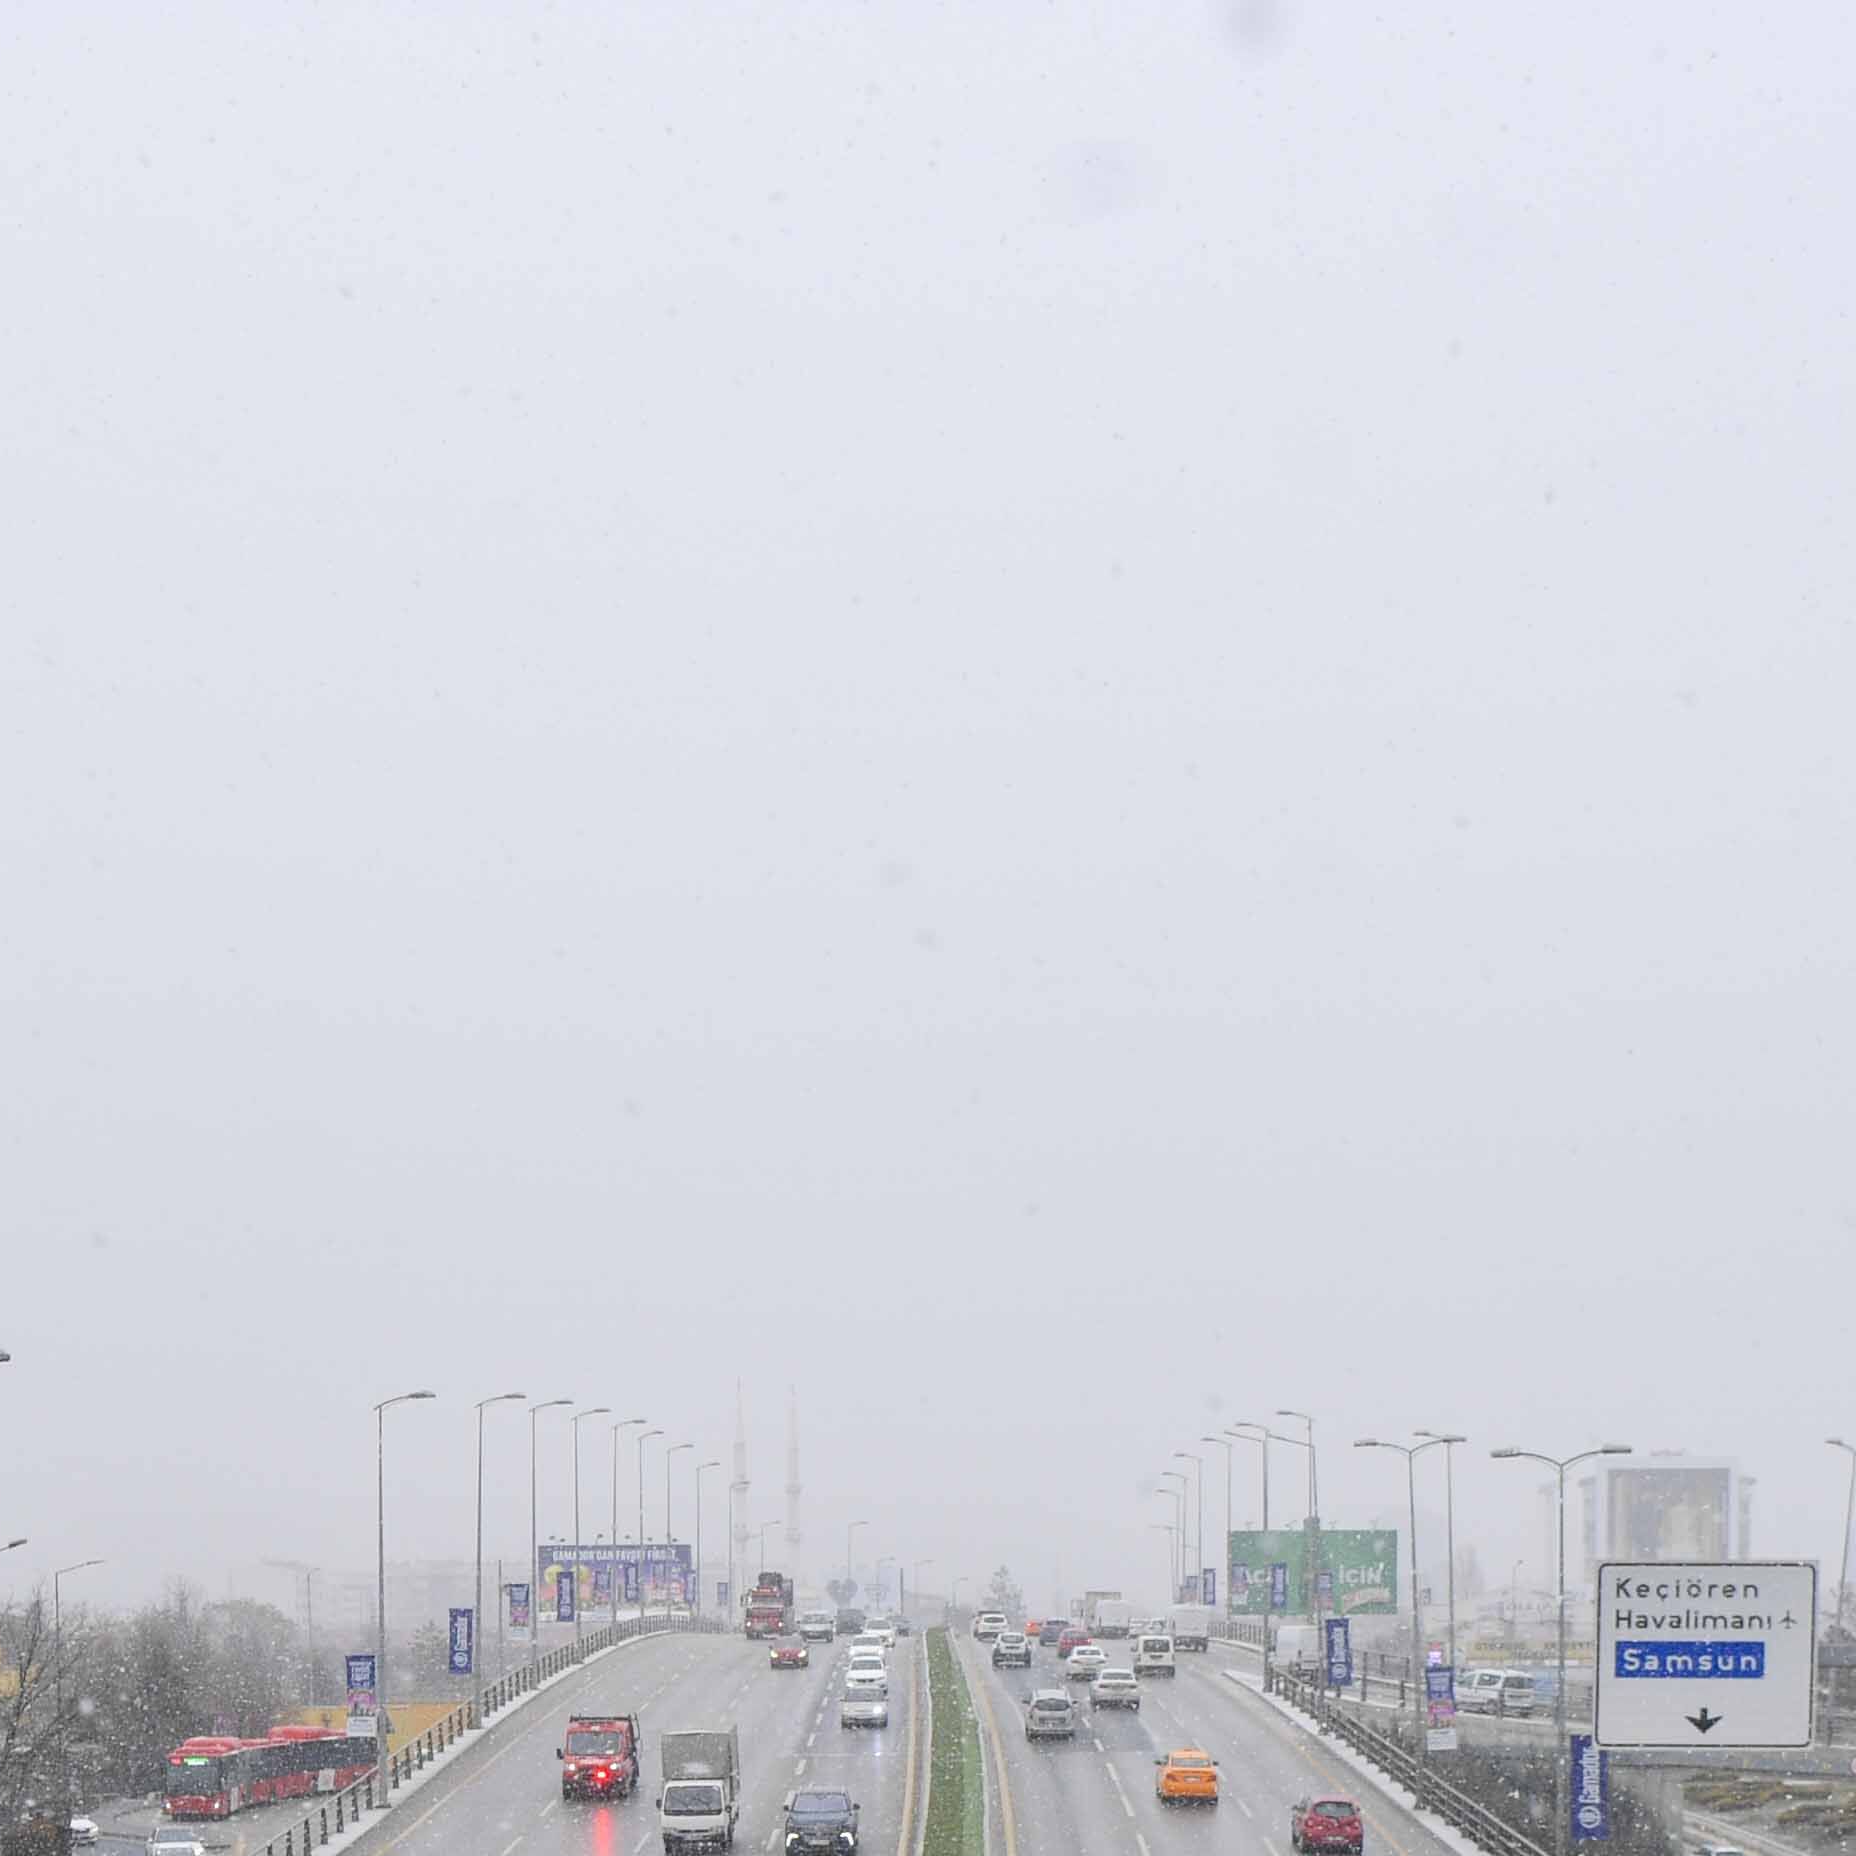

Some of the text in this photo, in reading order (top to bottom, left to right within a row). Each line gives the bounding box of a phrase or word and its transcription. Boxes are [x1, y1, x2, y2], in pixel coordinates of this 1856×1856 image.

[1615, 1577, 1759, 1601] Keçiören
[1615, 1609, 1772, 1630] Havalimanı
[1623, 1648, 1758, 1673] Samsun
